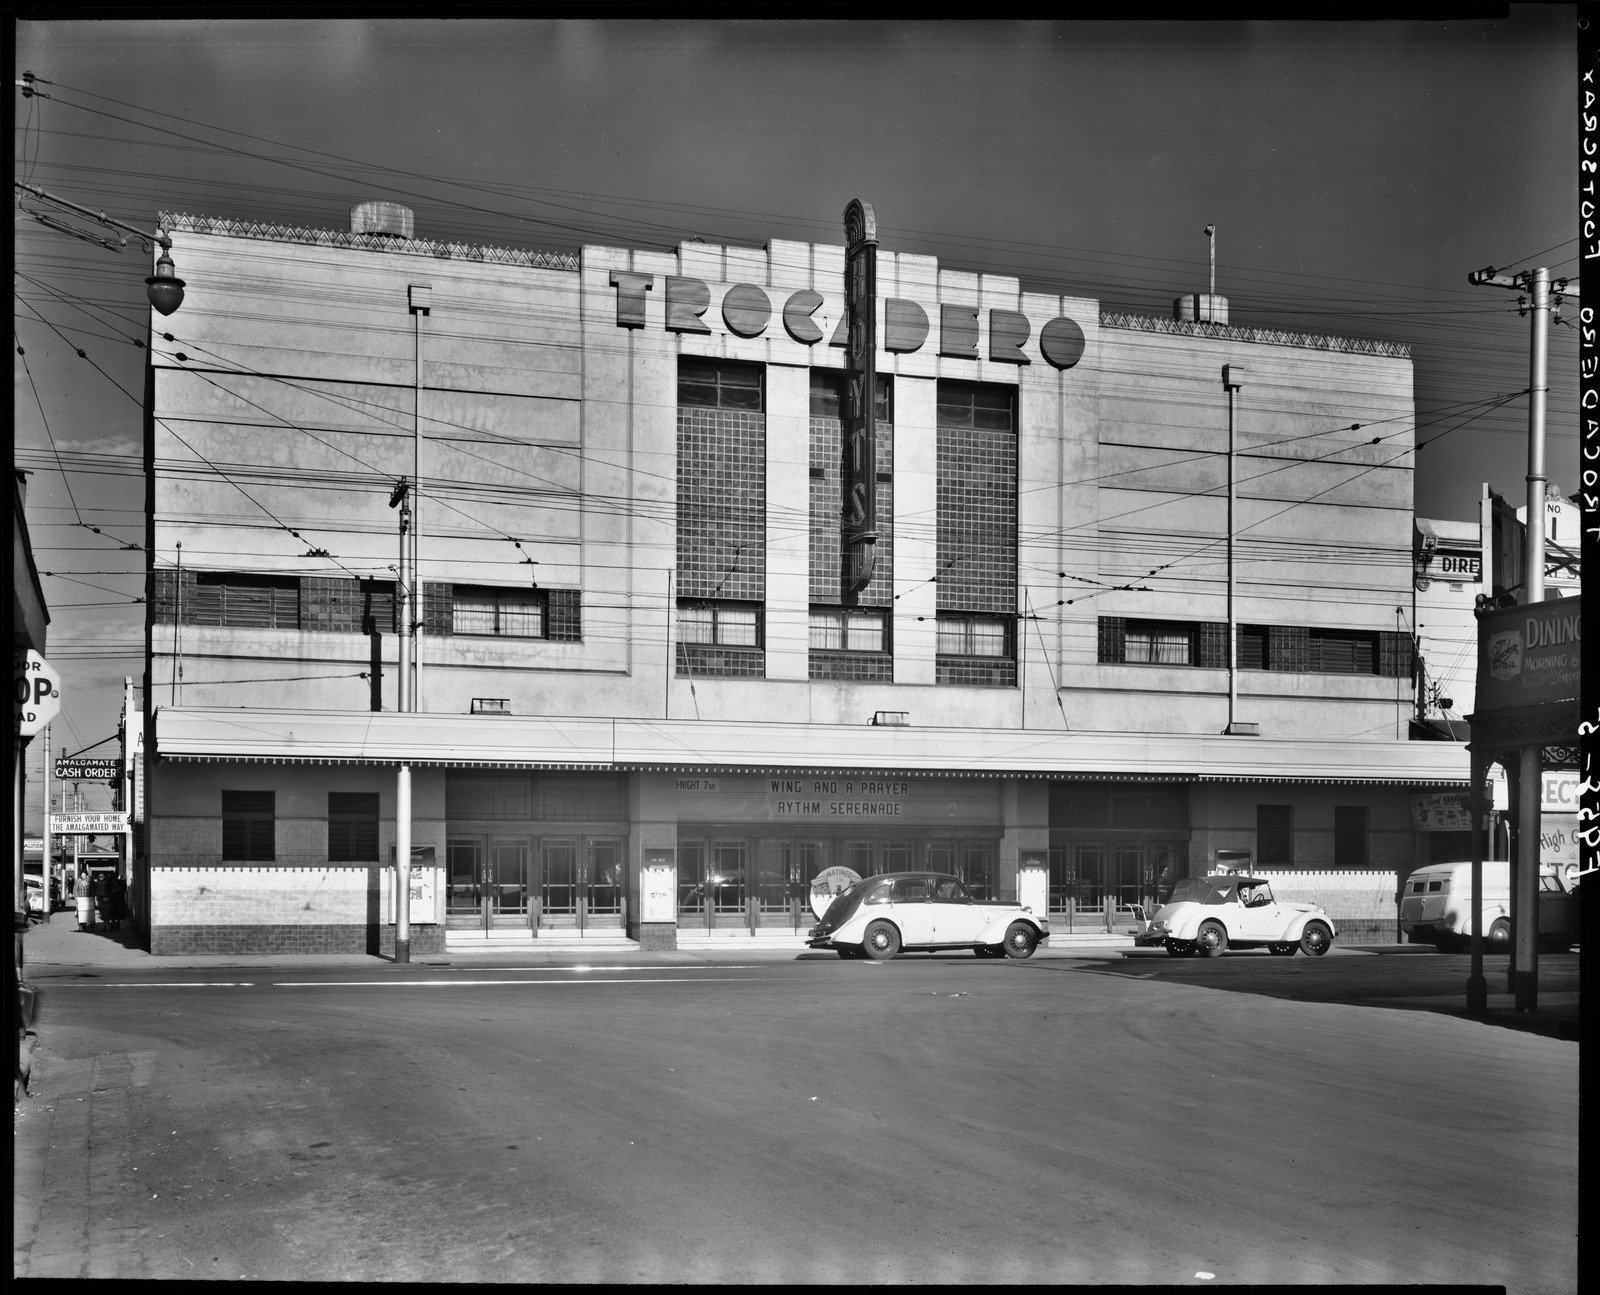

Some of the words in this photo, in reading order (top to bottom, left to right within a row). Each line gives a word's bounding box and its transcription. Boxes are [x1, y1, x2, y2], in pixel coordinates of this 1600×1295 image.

[1524, 654, 1568, 671] MORNING
[55, 767, 81, 778] CASH
[771, 781, 801, 793] WING
[814, 781, 837, 794] AND
[846, 782, 853, 794] A
[861, 782, 908, 795] PRAYER
[778, 801, 821, 814] RYTHM
[55, 815, 81, 823] FURNISH
[85, 814, 101, 823] YOUR
[104, 814, 121, 823] HOME
[52, 823, 63, 832] THE
[66, 823, 109, 832] AMALGAMATED
[112, 823, 124, 832] WAY
[826, 869, 853, 878] MATINEE
